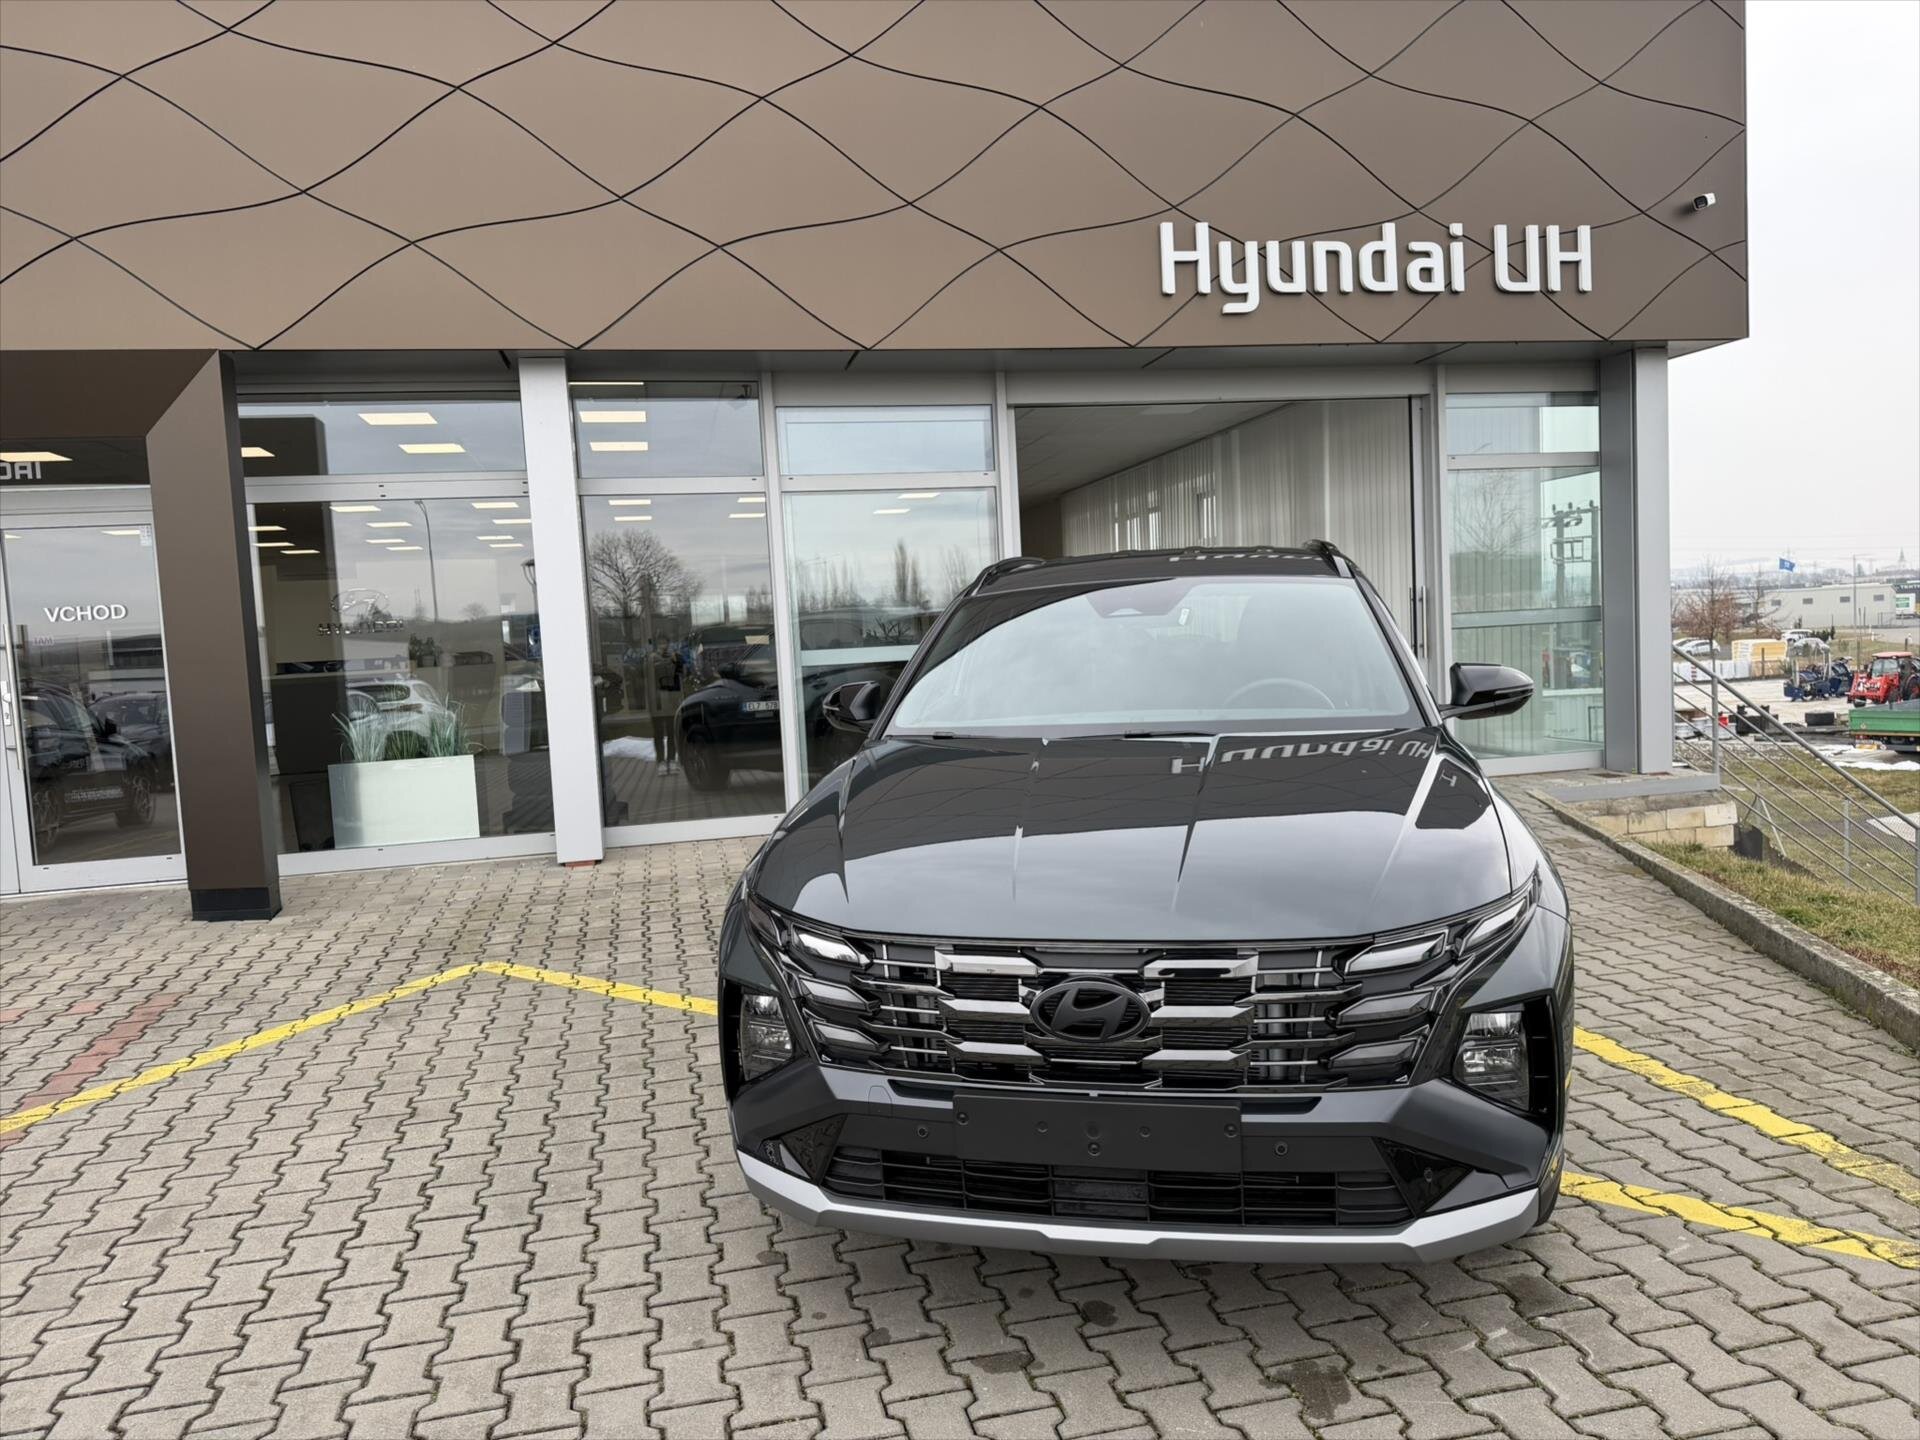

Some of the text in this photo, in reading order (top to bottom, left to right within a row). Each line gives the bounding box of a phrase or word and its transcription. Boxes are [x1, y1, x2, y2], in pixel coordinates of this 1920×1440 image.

[1159, 221, 1593, 315] Hyundai UH
[43, 603, 127, 623] VCHOD
